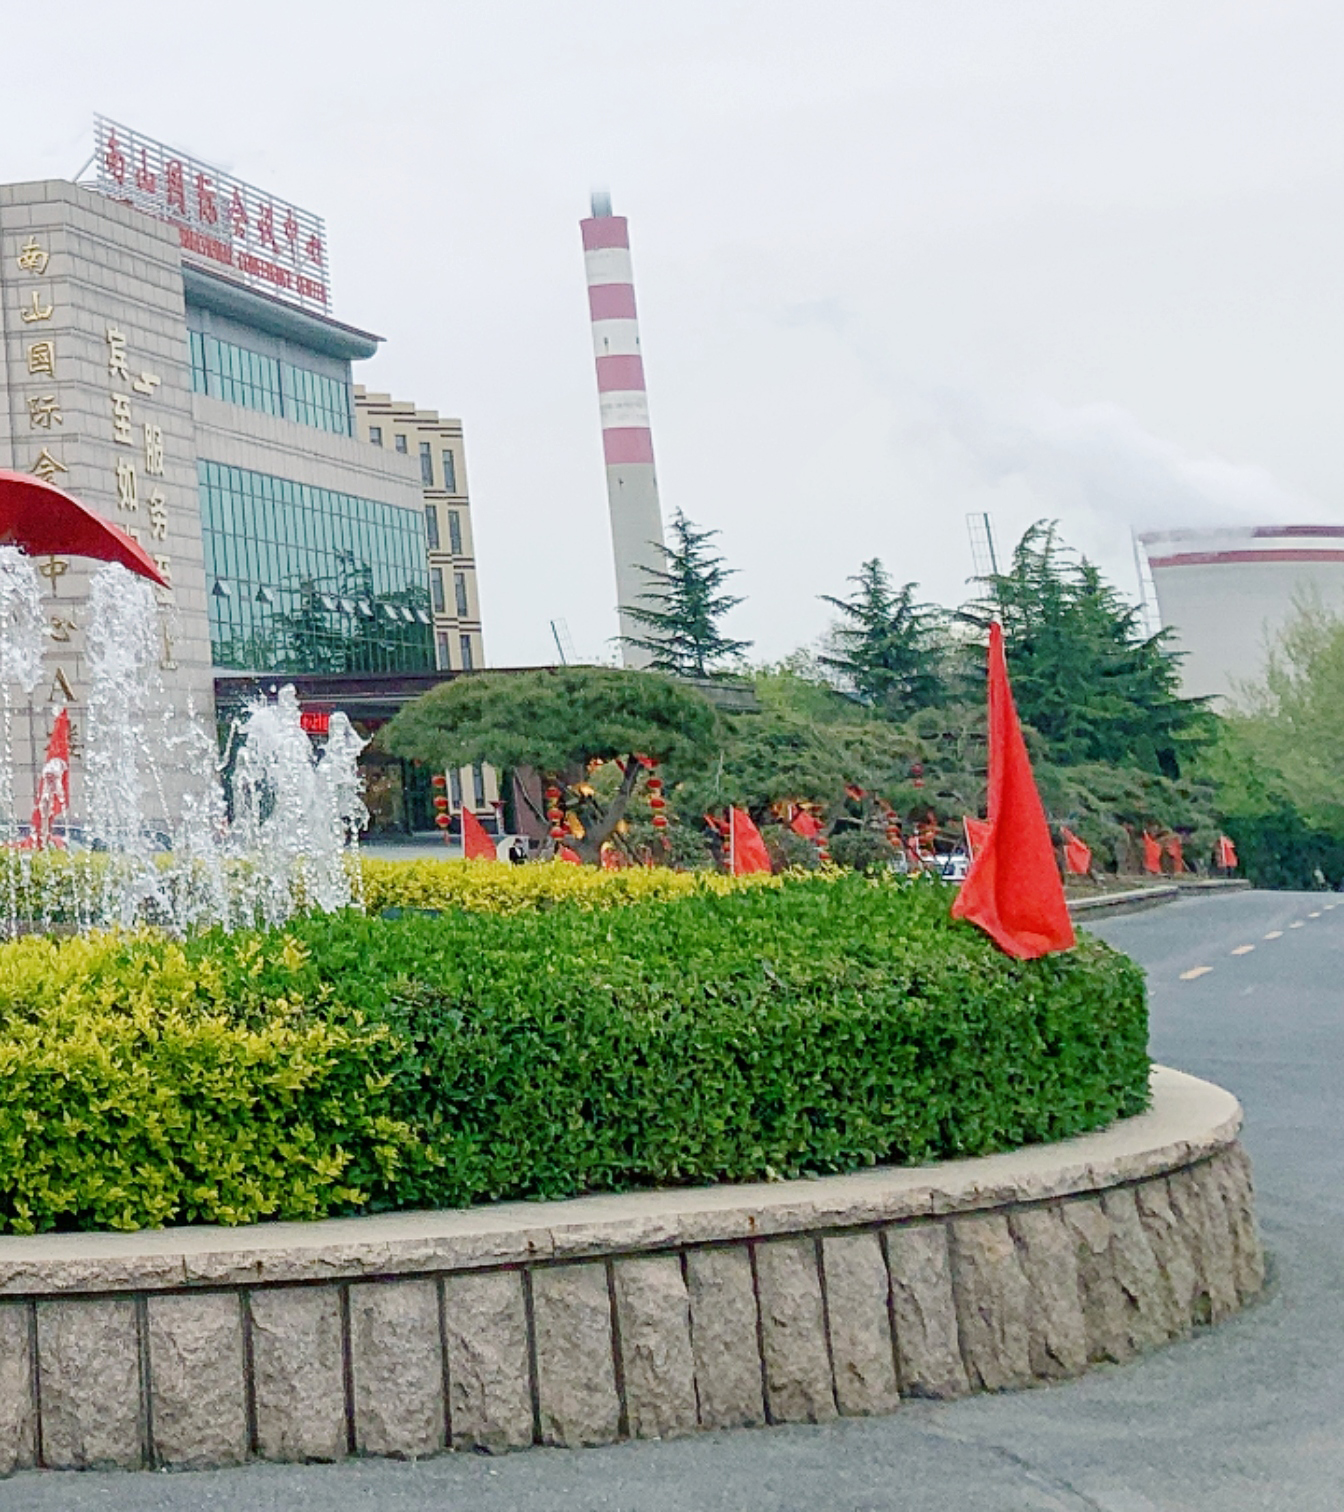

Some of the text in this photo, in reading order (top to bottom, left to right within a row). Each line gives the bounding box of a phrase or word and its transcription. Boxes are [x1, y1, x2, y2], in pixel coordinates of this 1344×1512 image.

[15, 236, 86, 760] 南山国际会中心A
[107, 326, 140, 545] 宾至如
